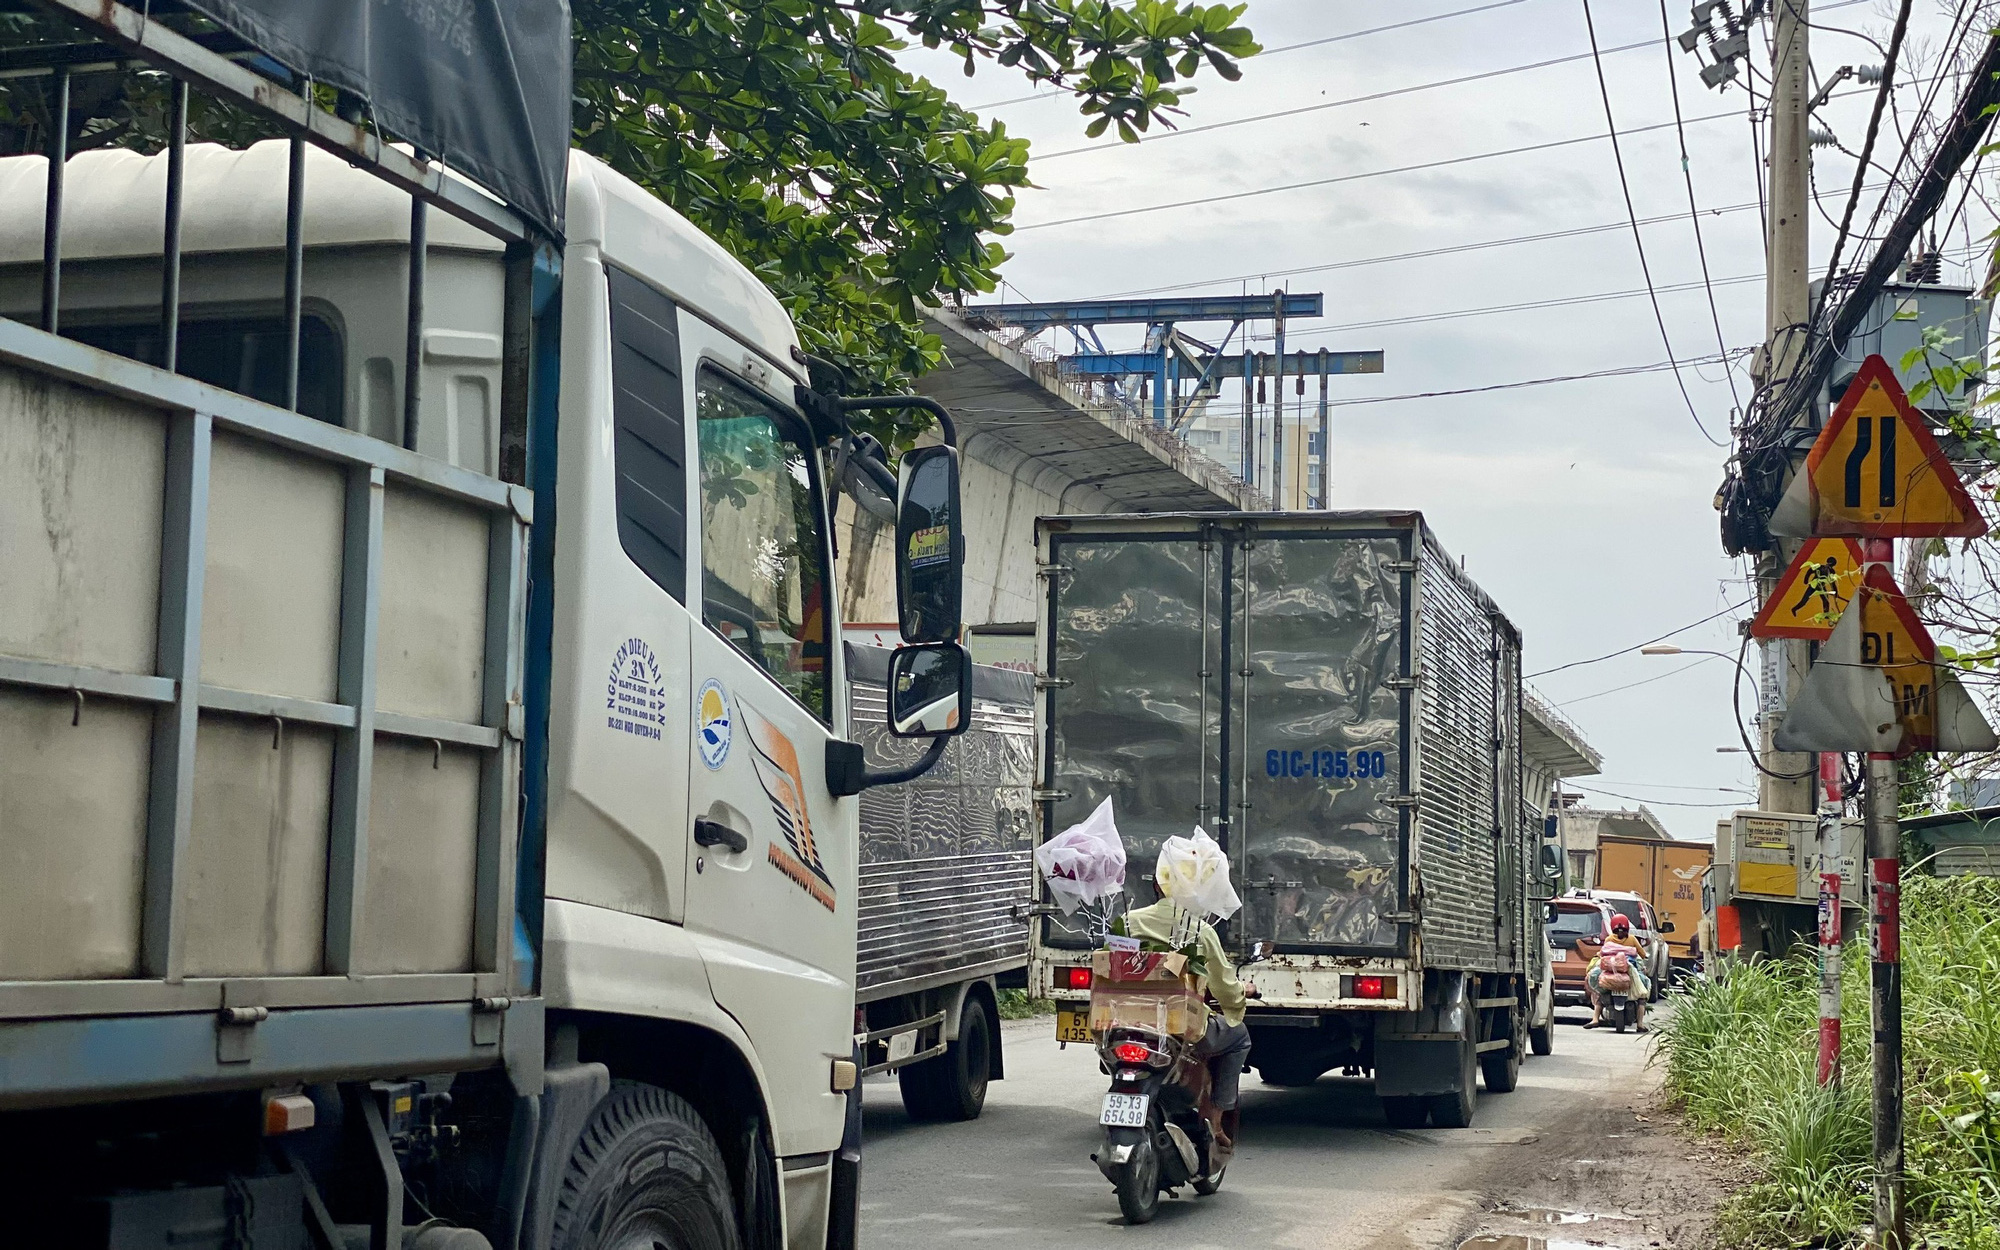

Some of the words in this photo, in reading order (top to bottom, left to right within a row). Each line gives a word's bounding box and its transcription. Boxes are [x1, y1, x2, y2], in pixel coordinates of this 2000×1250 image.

[1861, 631, 1894, 664] ĐI
[631, 659, 646, 679] 3N
[607, 642, 628, 709] NGUYEN
[628, 637, 649, 660] DIEU
[647, 651, 662, 685] HAI
[657, 686, 666, 727] VAN
[1266, 749, 1386, 779] 61C-135.90
[1064, 1028, 1094, 1042] 135.
[1109, 1095, 1142, 1110] 59-X3
[1103, 1109, 1143, 1124] 654.98
